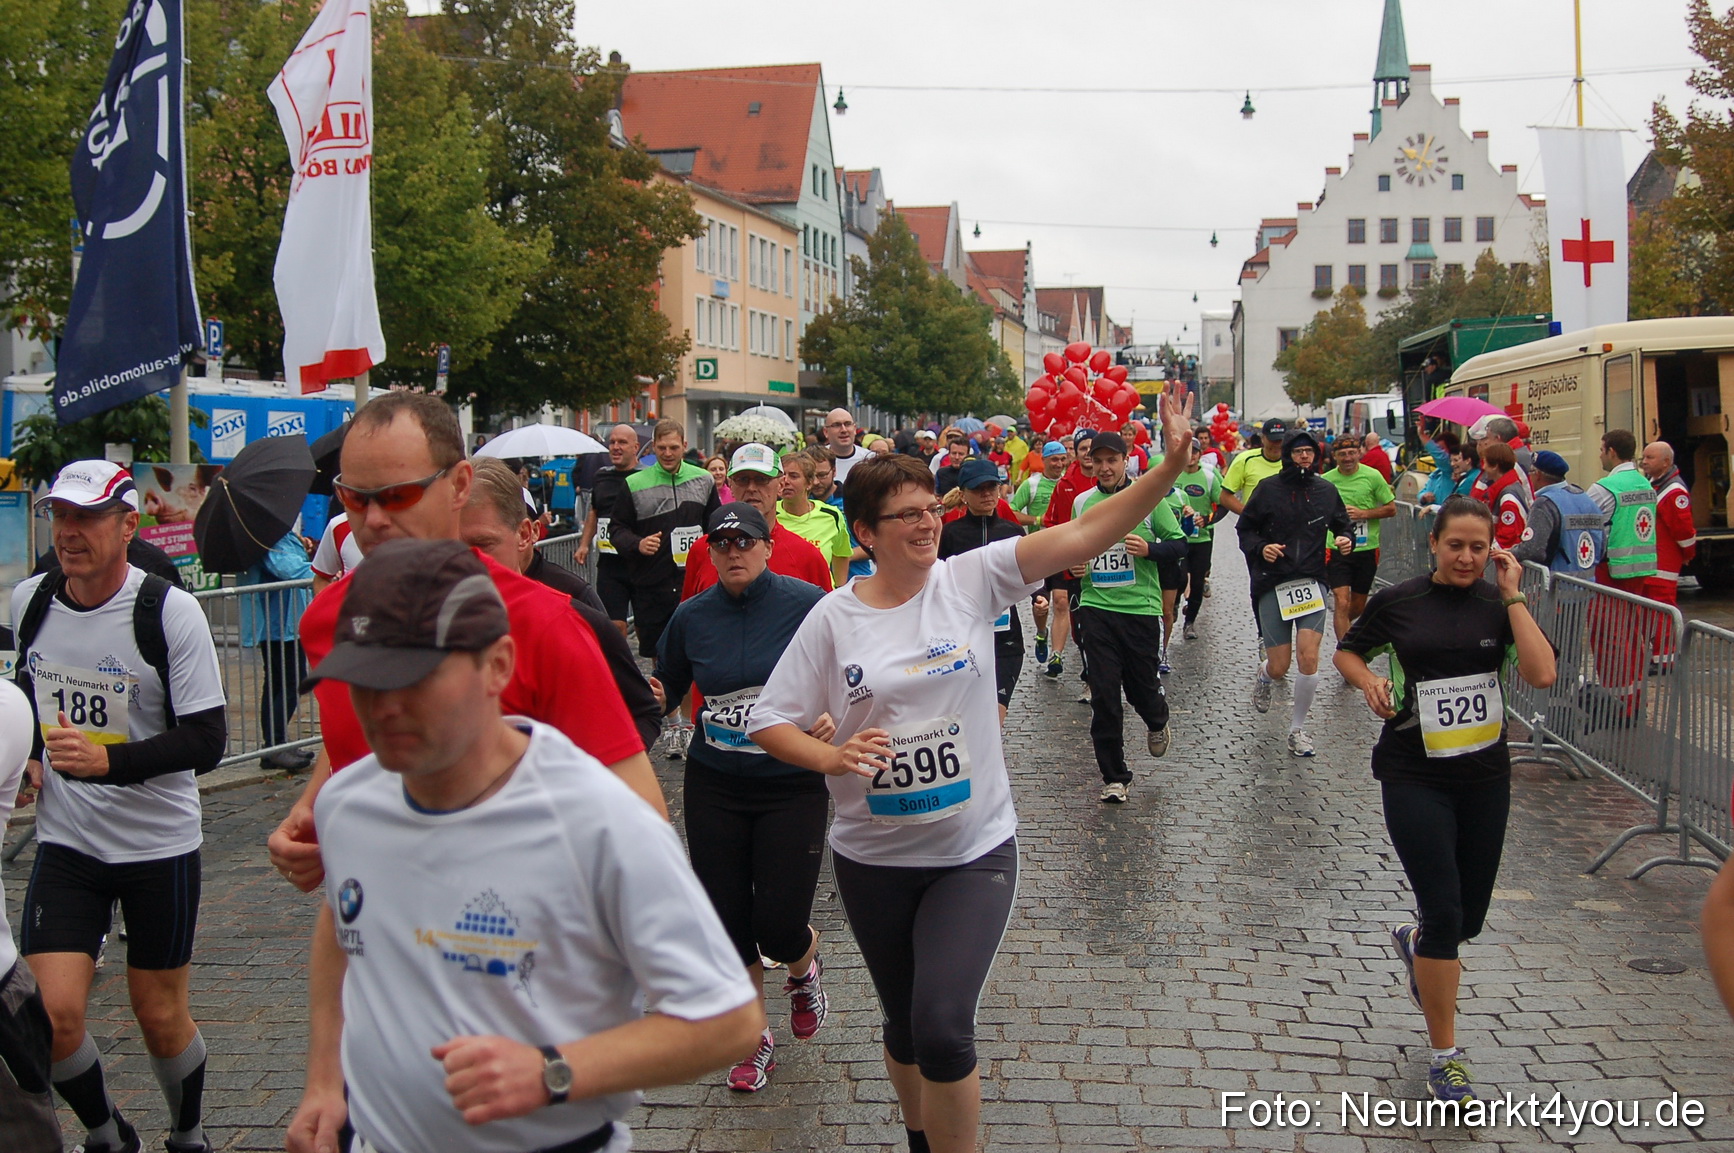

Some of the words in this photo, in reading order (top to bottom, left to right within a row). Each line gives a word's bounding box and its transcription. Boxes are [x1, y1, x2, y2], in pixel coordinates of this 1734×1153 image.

[698, 361, 715, 378] D
[1527, 374, 1578, 401] Bayerisches
[1527, 403, 1551, 422] Rotes
[213, 415, 245, 438] DIXI
[269, 417, 303, 437] DIXI
[1093, 553, 1129, 570] 2154
[1286, 587, 1313, 605] 193
[37, 669, 64, 684] PARTL
[66, 676, 109, 692] Neumarkt
[1419, 688, 1447, 698] PARTL
[1448, 682, 1487, 694] Neumarkt
[51, 688, 108, 728] 188
[1437, 693, 1488, 727] 529
[892, 729, 945, 748] Neumarkt
[872, 742, 961, 789] 2596
[899, 795, 941, 812] Sonja
